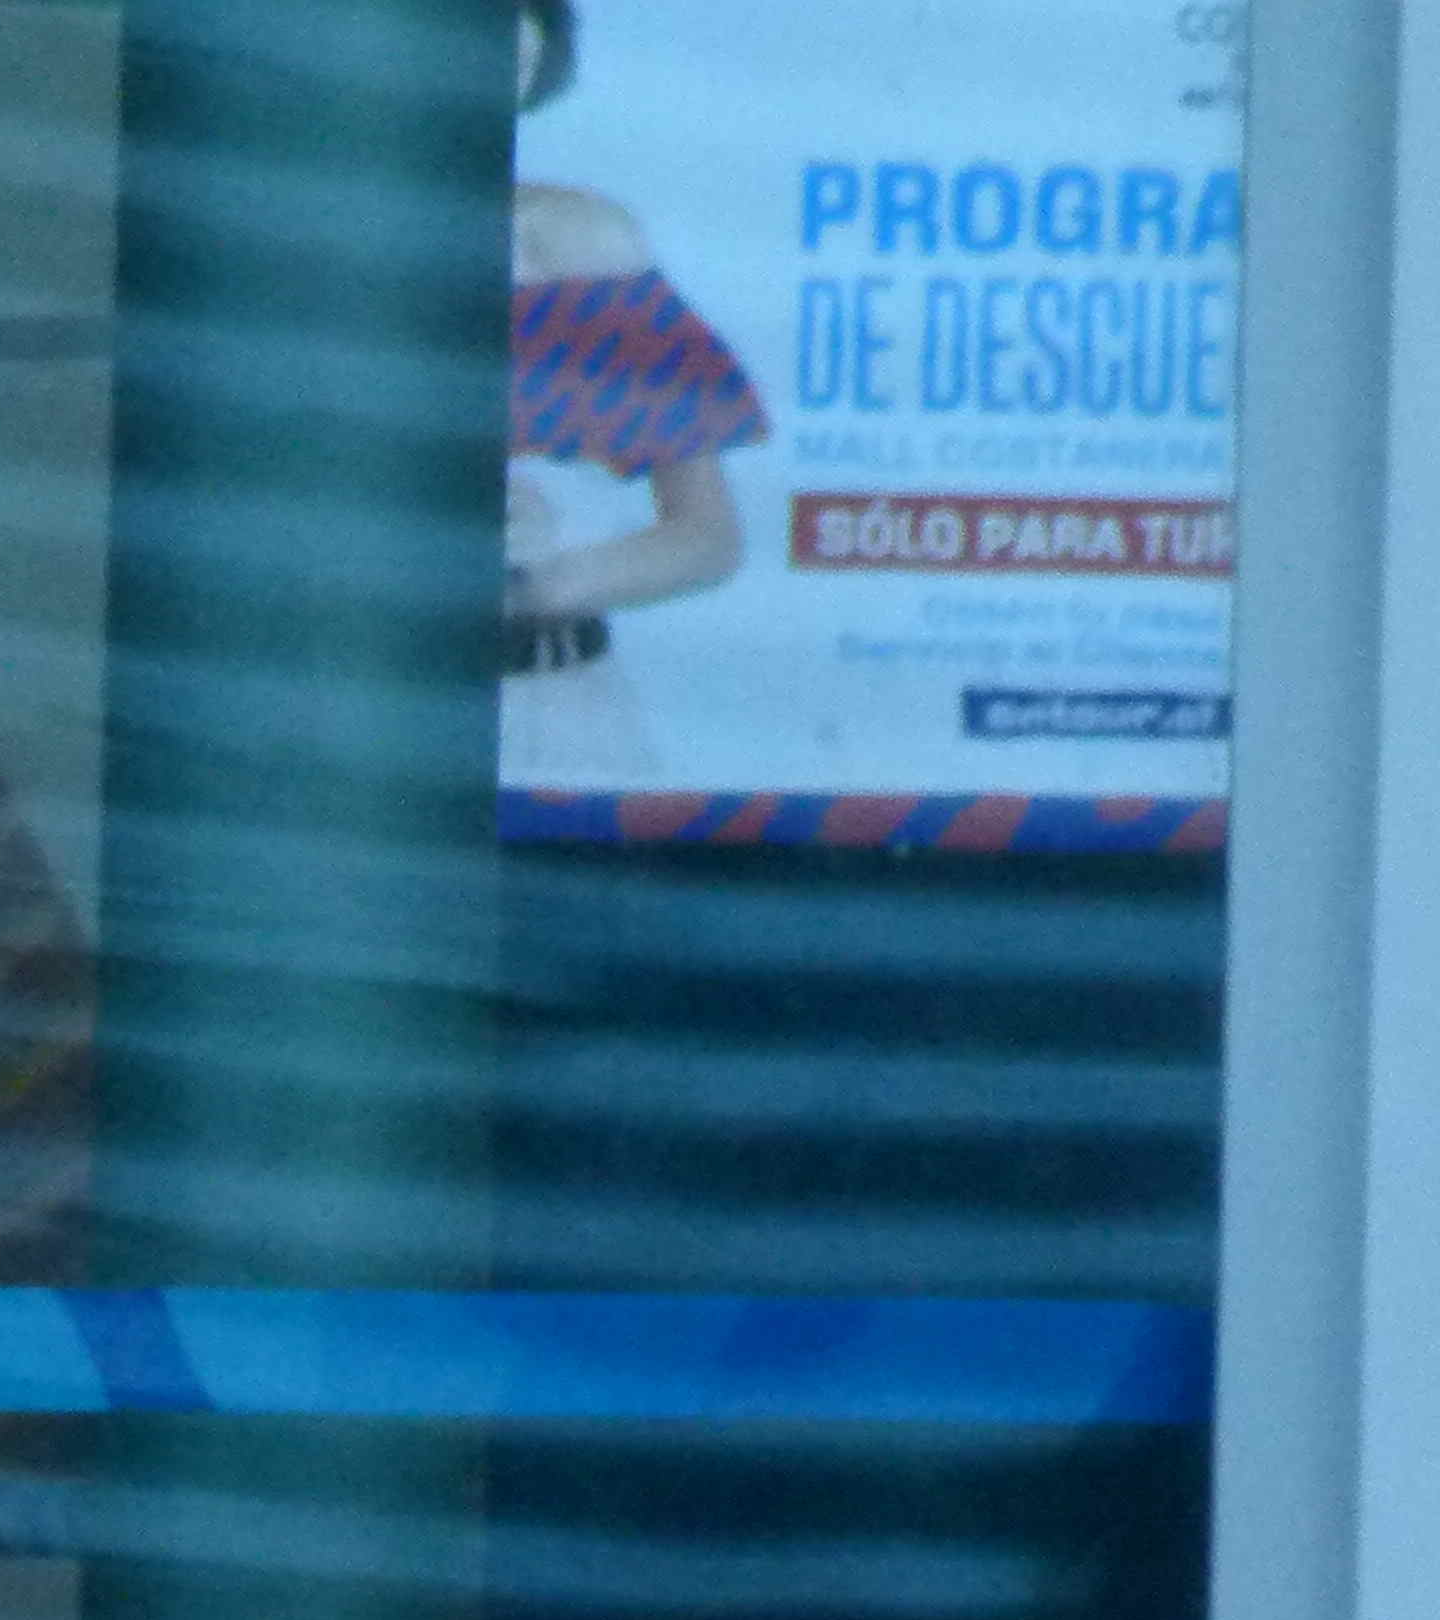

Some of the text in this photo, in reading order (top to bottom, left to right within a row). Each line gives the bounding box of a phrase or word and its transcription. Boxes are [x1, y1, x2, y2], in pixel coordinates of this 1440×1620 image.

[801, 160, 1242, 256] PROGRA
[796, 274, 1223, 418] DE DESCUE
[794, 429, 915, 469] MALL
[817, 498, 966, 560] SÓLO
[978, 512, 1128, 561] PARA
